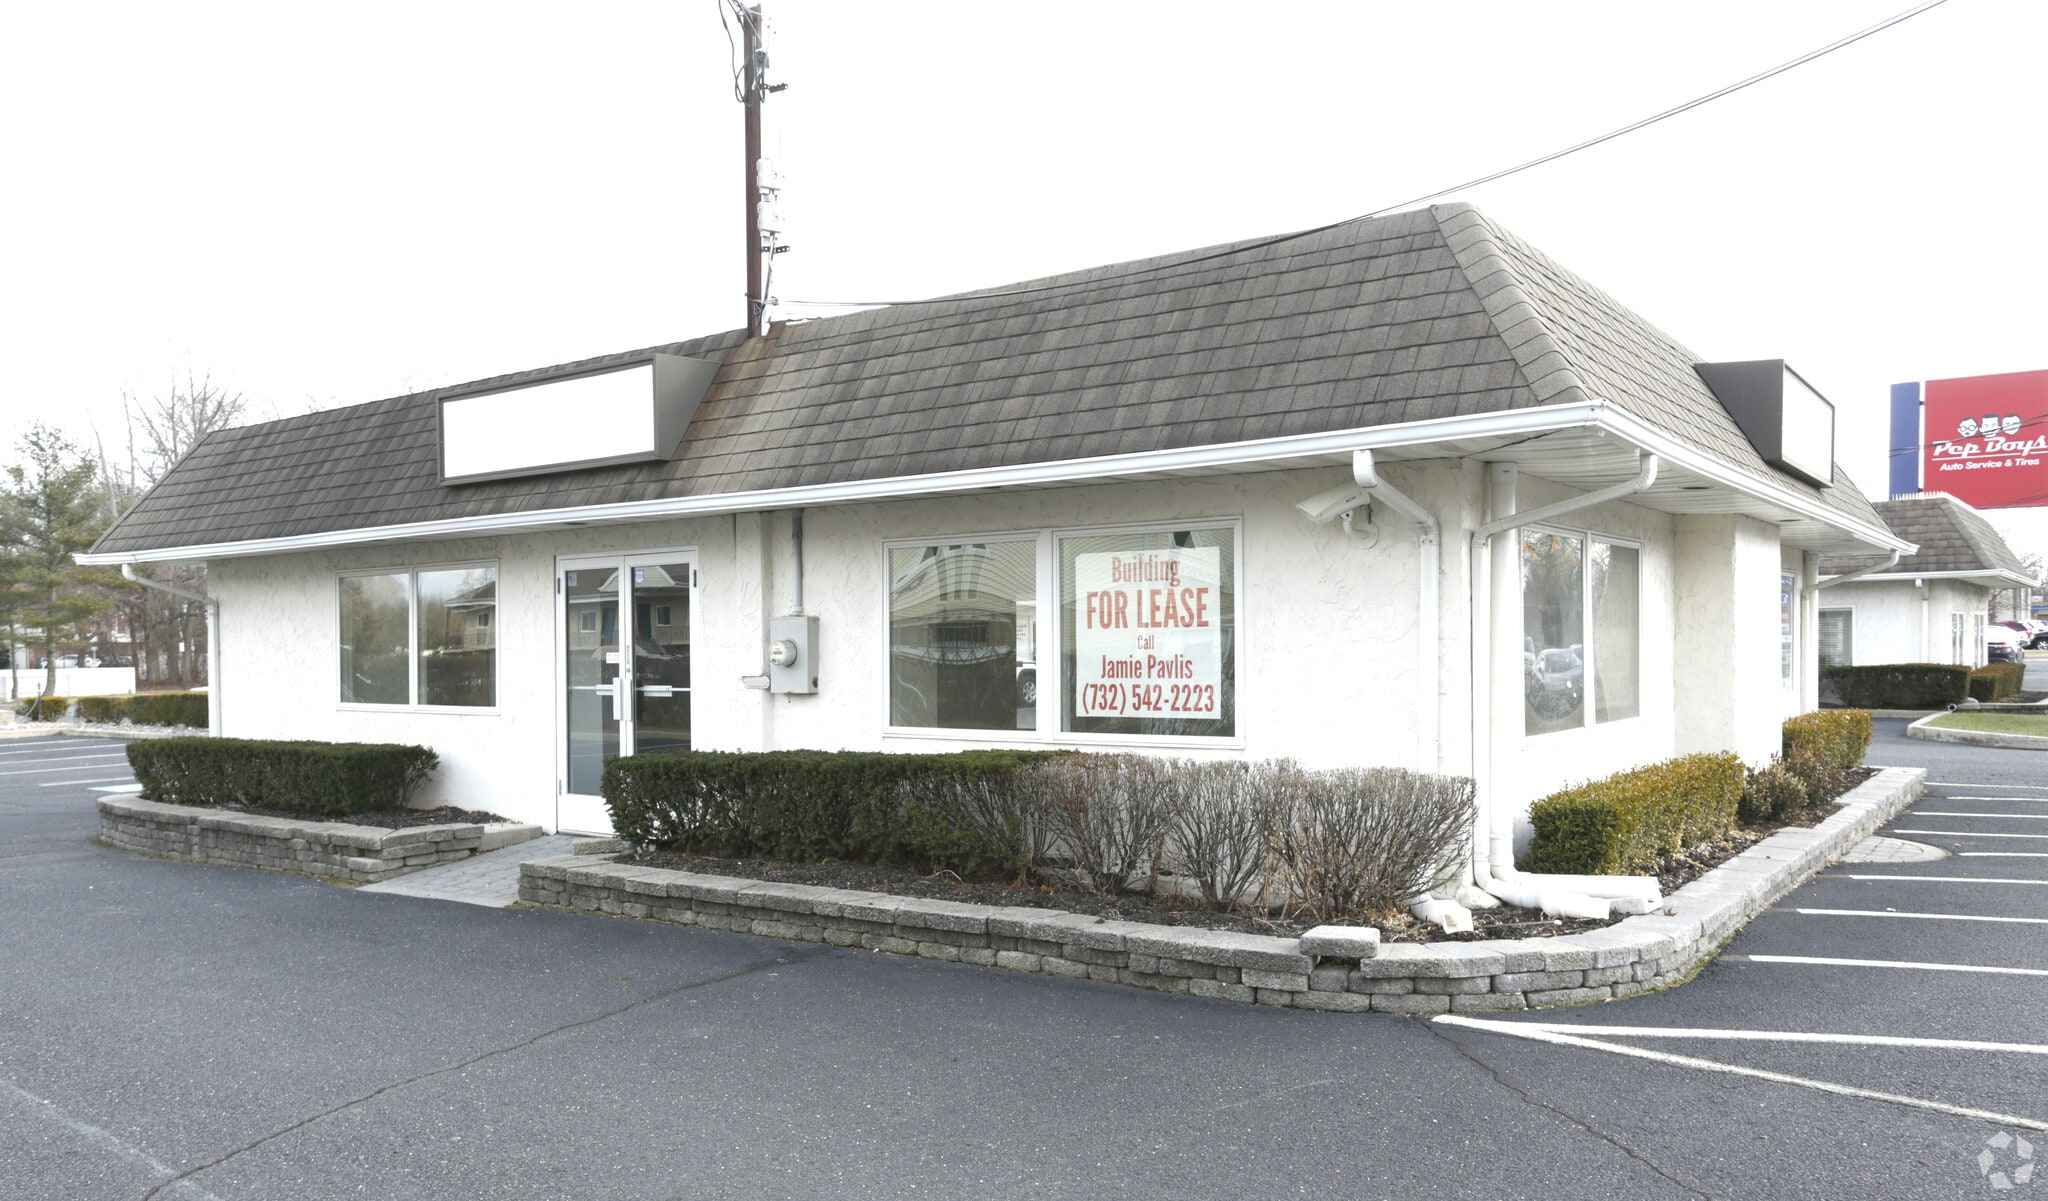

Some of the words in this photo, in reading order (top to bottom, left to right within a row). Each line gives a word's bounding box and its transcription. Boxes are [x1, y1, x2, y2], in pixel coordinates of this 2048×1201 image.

[1931, 440, 1981, 458] Pep
[1984, 435, 2048, 456] Boys
[1939, 462, 1964, 471] Auto
[1965, 460, 2001, 470] Service
[2004, 458, 2012, 467] &
[2015, 458, 2040, 466] Tires
[1111, 553, 1181, 587] Building
[1086, 590, 1129, 629] FOR
[1137, 587, 1209, 628] LEASE
[1137, 635, 1155, 650] Call
[1101, 654, 1142, 679] Jamie
[1147, 654, 1193, 679] Pavlis
[1082, 683, 1126, 715] (732)
[1132, 684, 1214, 712] 542-2223
